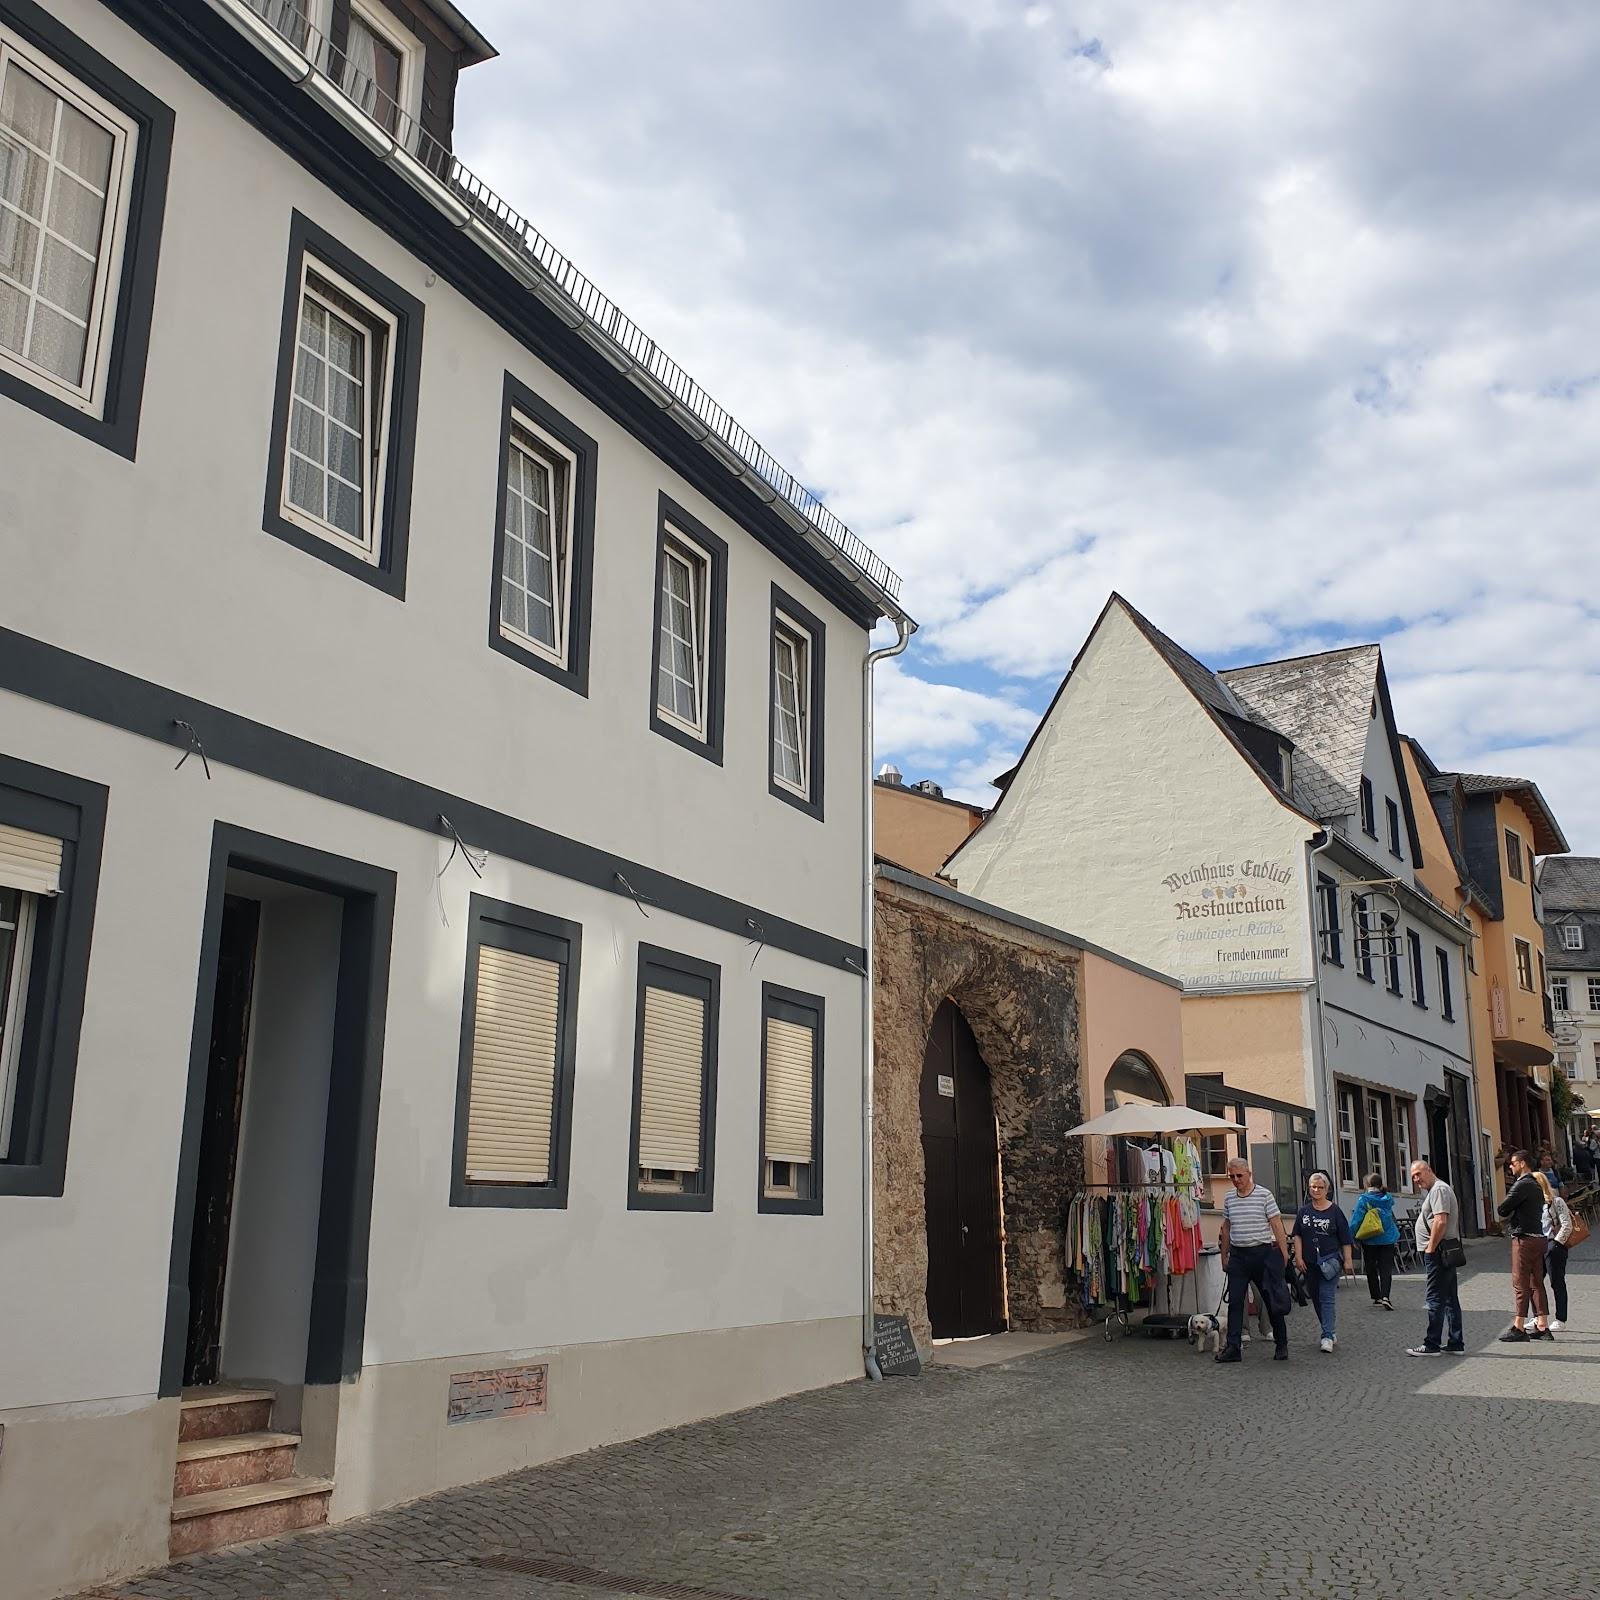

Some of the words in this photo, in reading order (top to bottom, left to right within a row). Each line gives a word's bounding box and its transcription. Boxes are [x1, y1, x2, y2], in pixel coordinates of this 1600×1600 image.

[1161, 862, 1235, 893] Weinhaus
[1241, 860, 1293, 885] Endlich
[1174, 896, 1287, 922] Restauration
[1217, 947, 1290, 962] Fremdenzimmer
